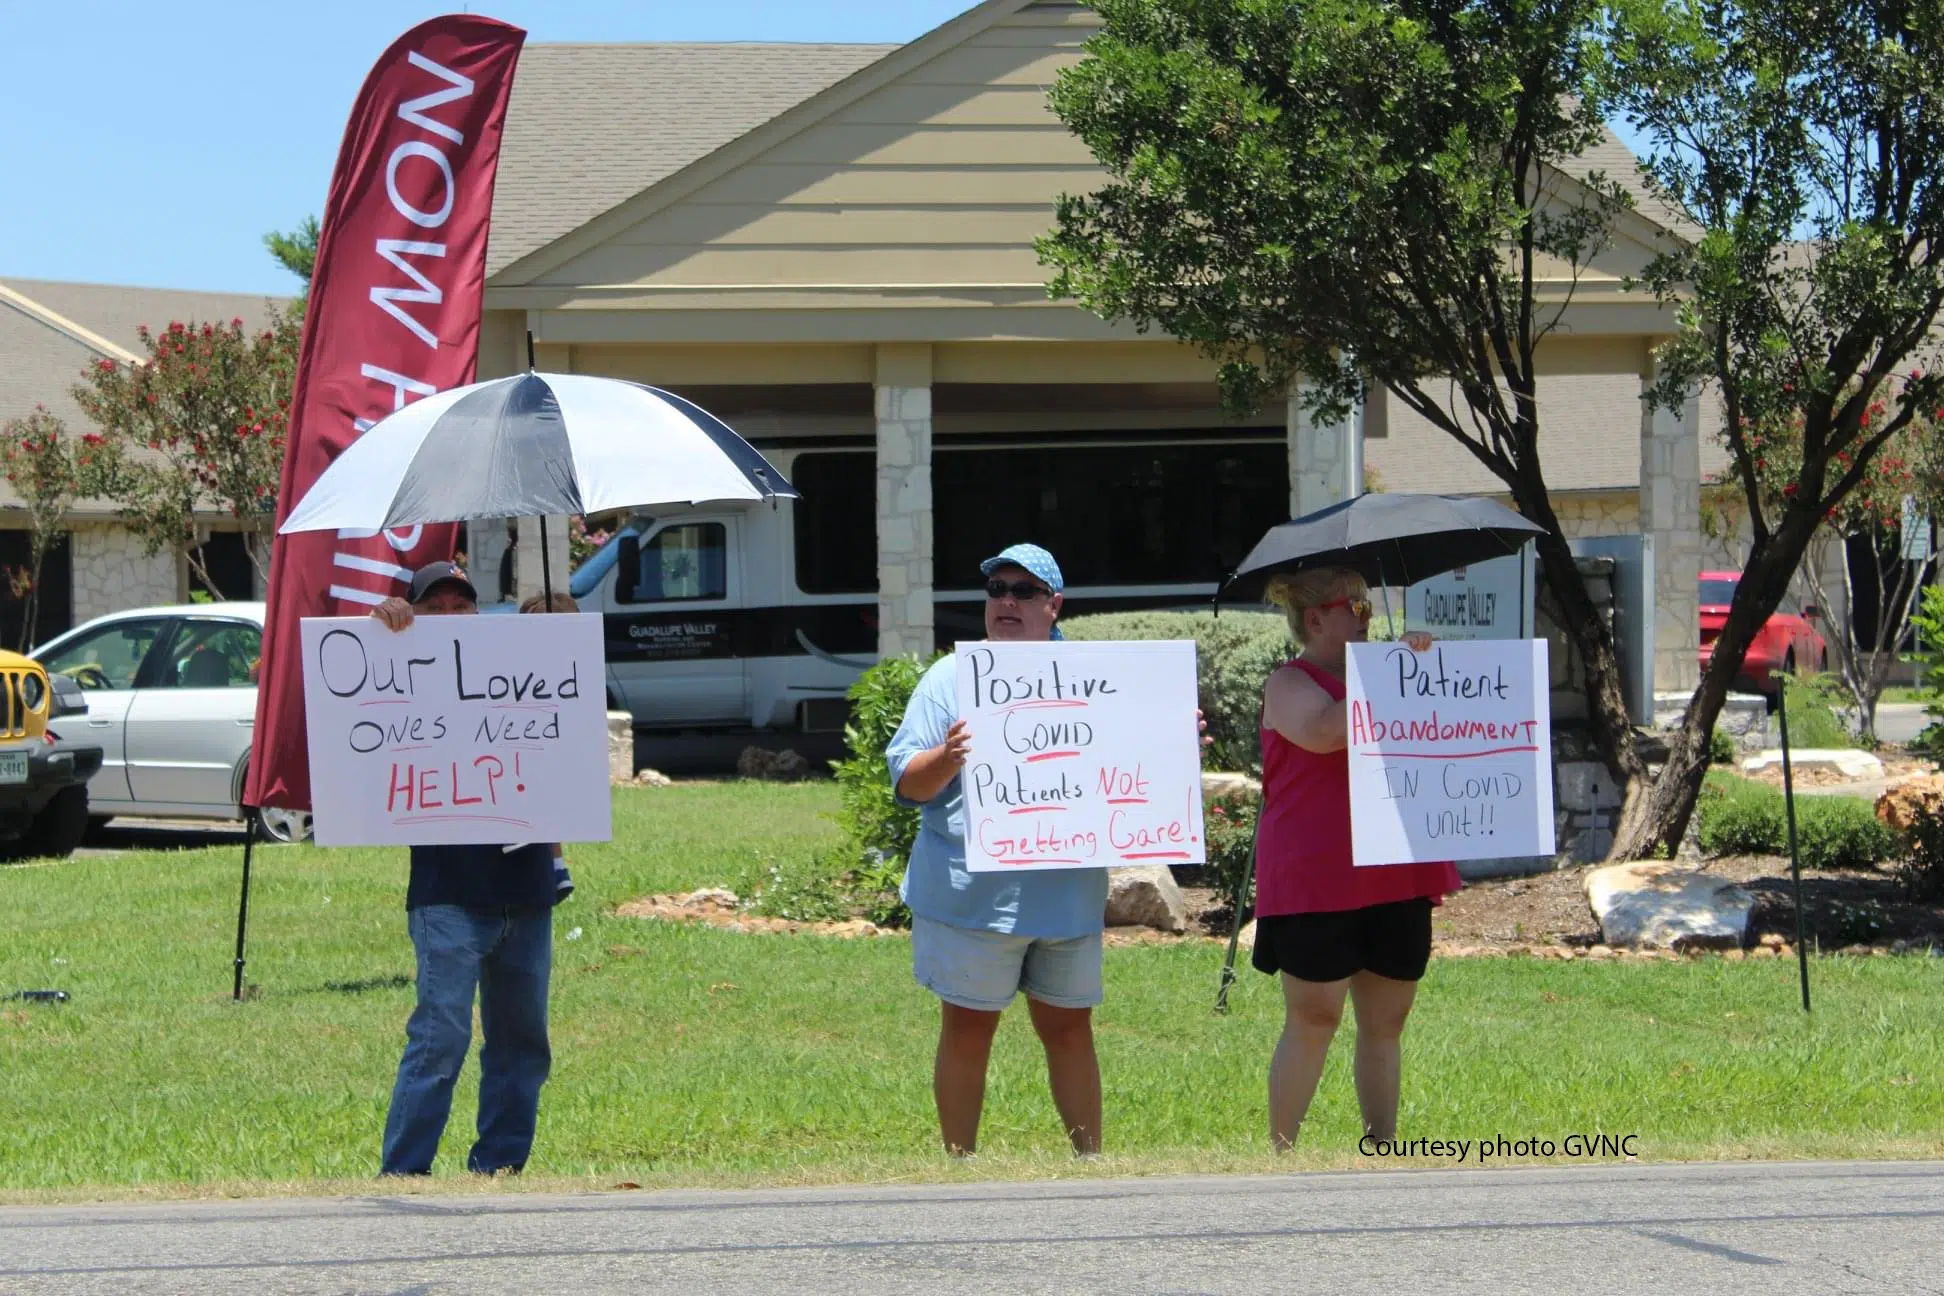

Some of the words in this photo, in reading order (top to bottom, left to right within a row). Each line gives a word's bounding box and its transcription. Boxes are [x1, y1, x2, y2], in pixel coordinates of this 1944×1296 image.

[369, 50, 475, 349] NOW
[683, 623, 717, 635] VALLEY
[1467, 586, 1496, 626] VALLEY
[319, 629, 436, 698] Our
[453, 639, 579, 701] Loved
[965, 648, 1117, 708] Positive
[1385, 647, 1509, 700] Patient
[386, 752, 526, 812] HELP!
[972, 763, 1083, 808] Patients
[979, 818, 1097, 858] Getting
[1109, 785, 1197, 850] Care!
